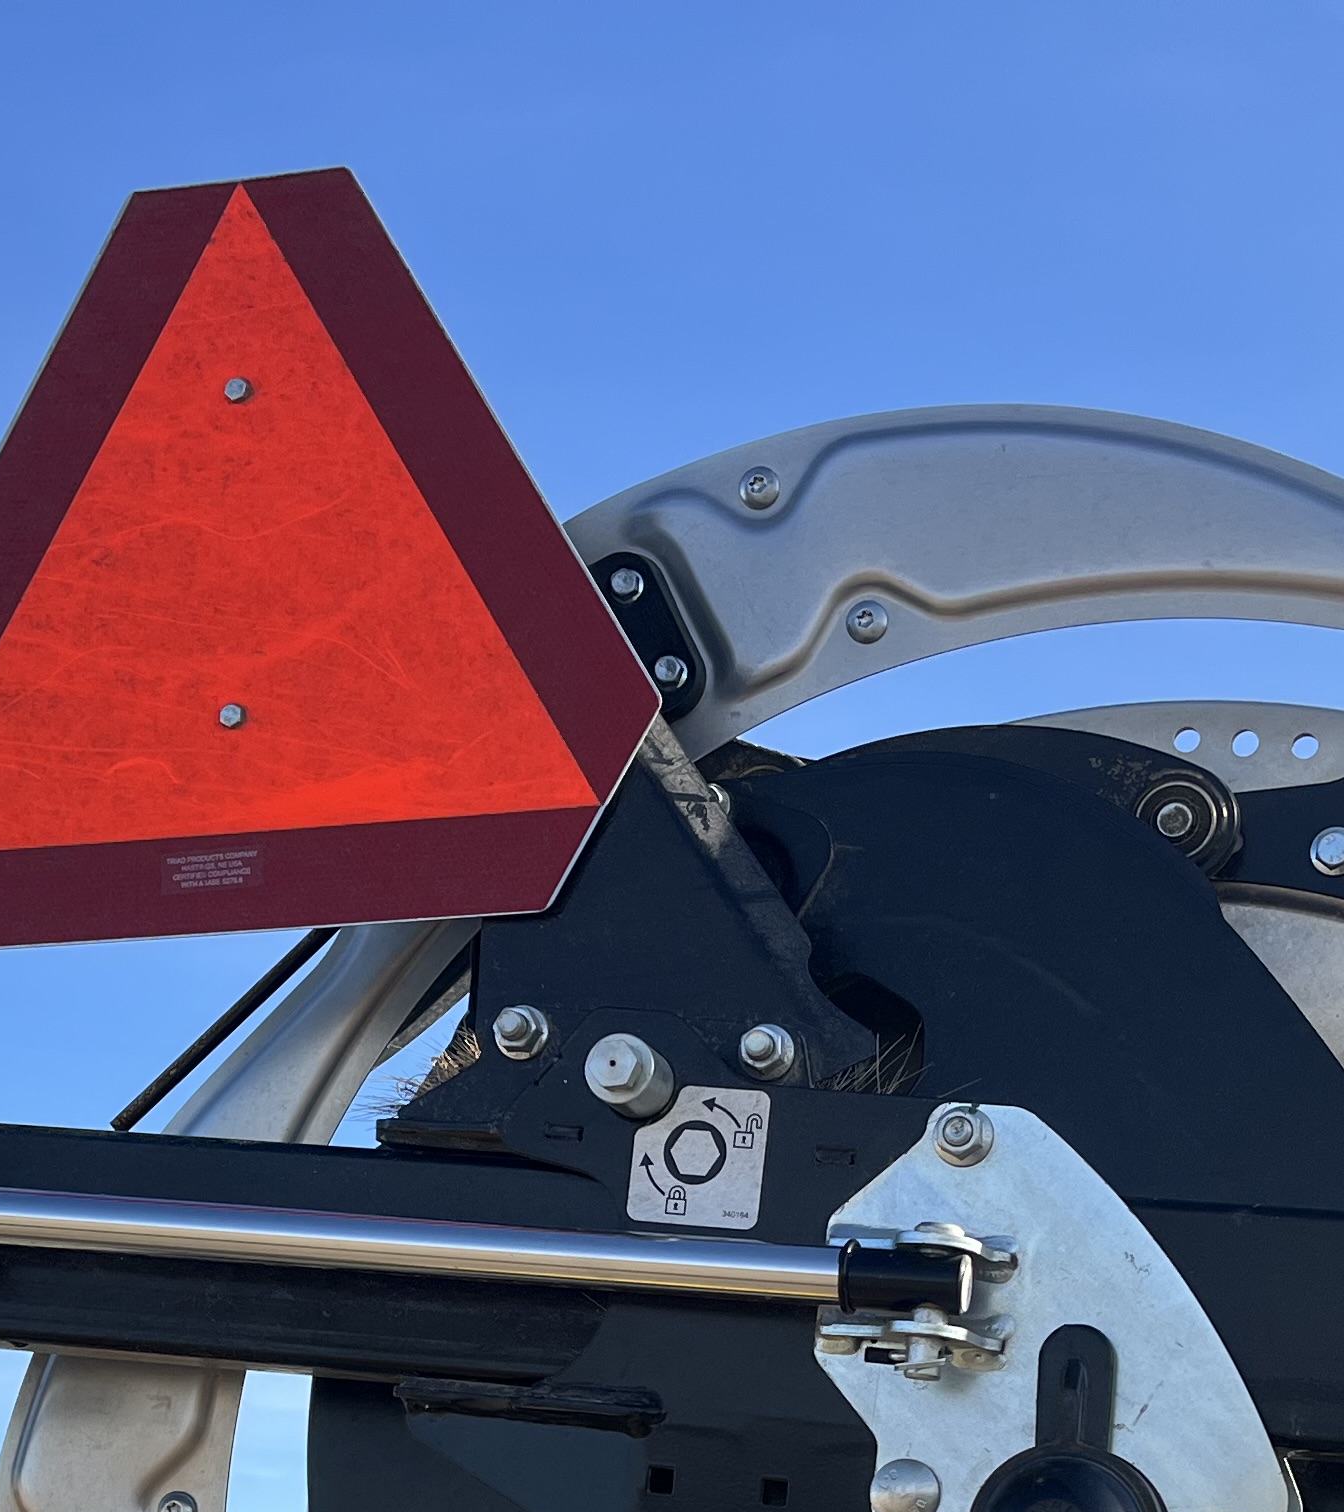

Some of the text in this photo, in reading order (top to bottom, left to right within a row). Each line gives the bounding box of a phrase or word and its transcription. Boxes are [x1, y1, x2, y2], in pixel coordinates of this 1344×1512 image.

[187, 853, 224, 863] PRODUCTS
[224, 850, 258, 859] COMPANY
[172, 867, 251, 881] CERTIFIED COMPLIANCE
